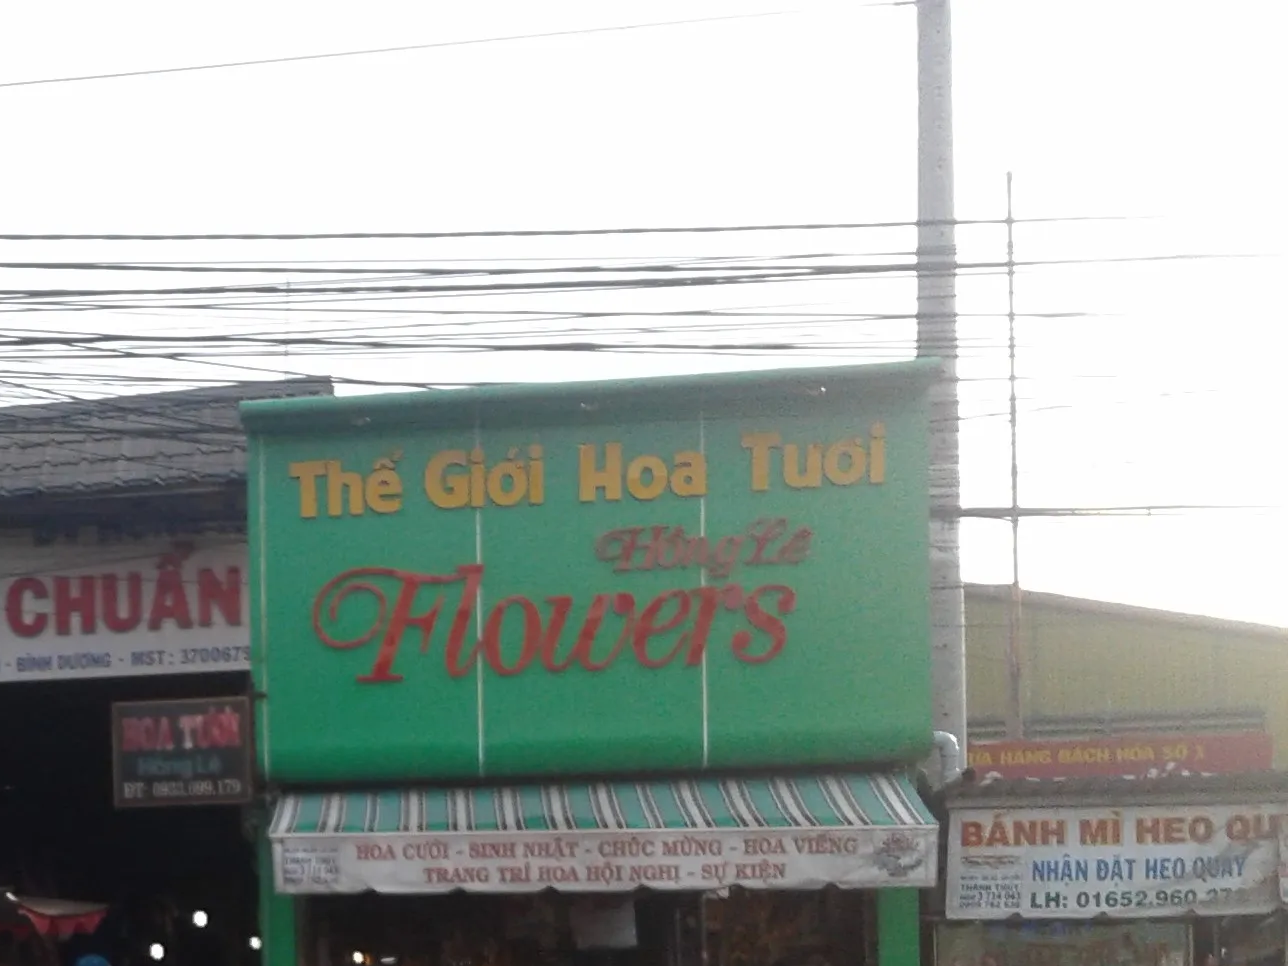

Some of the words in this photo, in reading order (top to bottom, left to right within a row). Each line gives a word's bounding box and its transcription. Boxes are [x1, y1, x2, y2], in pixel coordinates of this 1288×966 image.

[288, 446, 405, 519] Thế
[424, 443, 545, 510] Giới
[578, 441, 708, 503] Hoa
[314, 563, 797, 684] Flowers
[960, 810, 1067, 848] BÁNH
[1079, 809, 1123, 846] MÌ
[1135, 815, 1215, 845] HEO
[469, 840, 517, 860] SINH
[743, 837, 786, 856] HOA
[1031, 852, 1089, 888] NHẬN
[1144, 856, 1187, 881] HEO
[1192, 854, 1247, 883] QUAY
[1029, 890, 1069, 909] LH:
